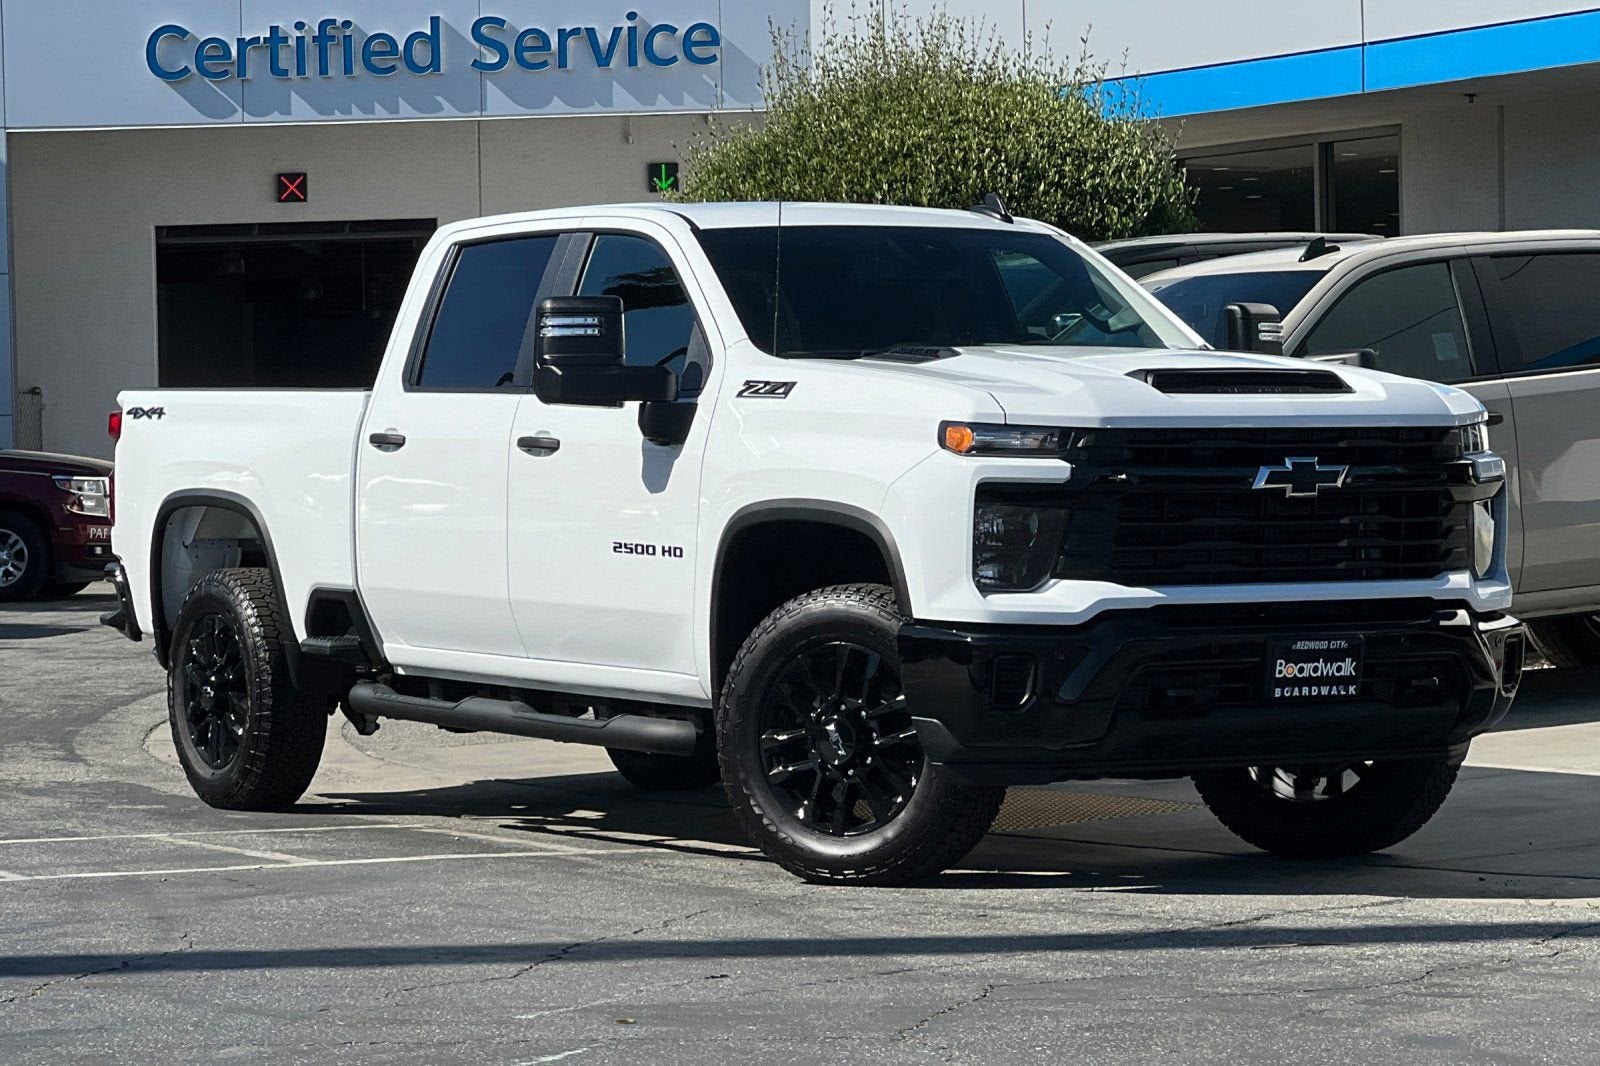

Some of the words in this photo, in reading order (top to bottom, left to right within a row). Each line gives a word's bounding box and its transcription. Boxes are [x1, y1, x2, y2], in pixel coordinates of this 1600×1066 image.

[145, 15, 442, 81] Certified
[470, 11, 721, 72] Service
[613, 541, 656, 556] 2500
[661, 545, 683, 558] HD
[1296, 641, 1328, 650] REDWOOD
[1330, 640, 1345, 649] CITY
[1275, 658, 1356, 678] Boardwalk
[1274, 685, 1356, 697] BOARDWALK
